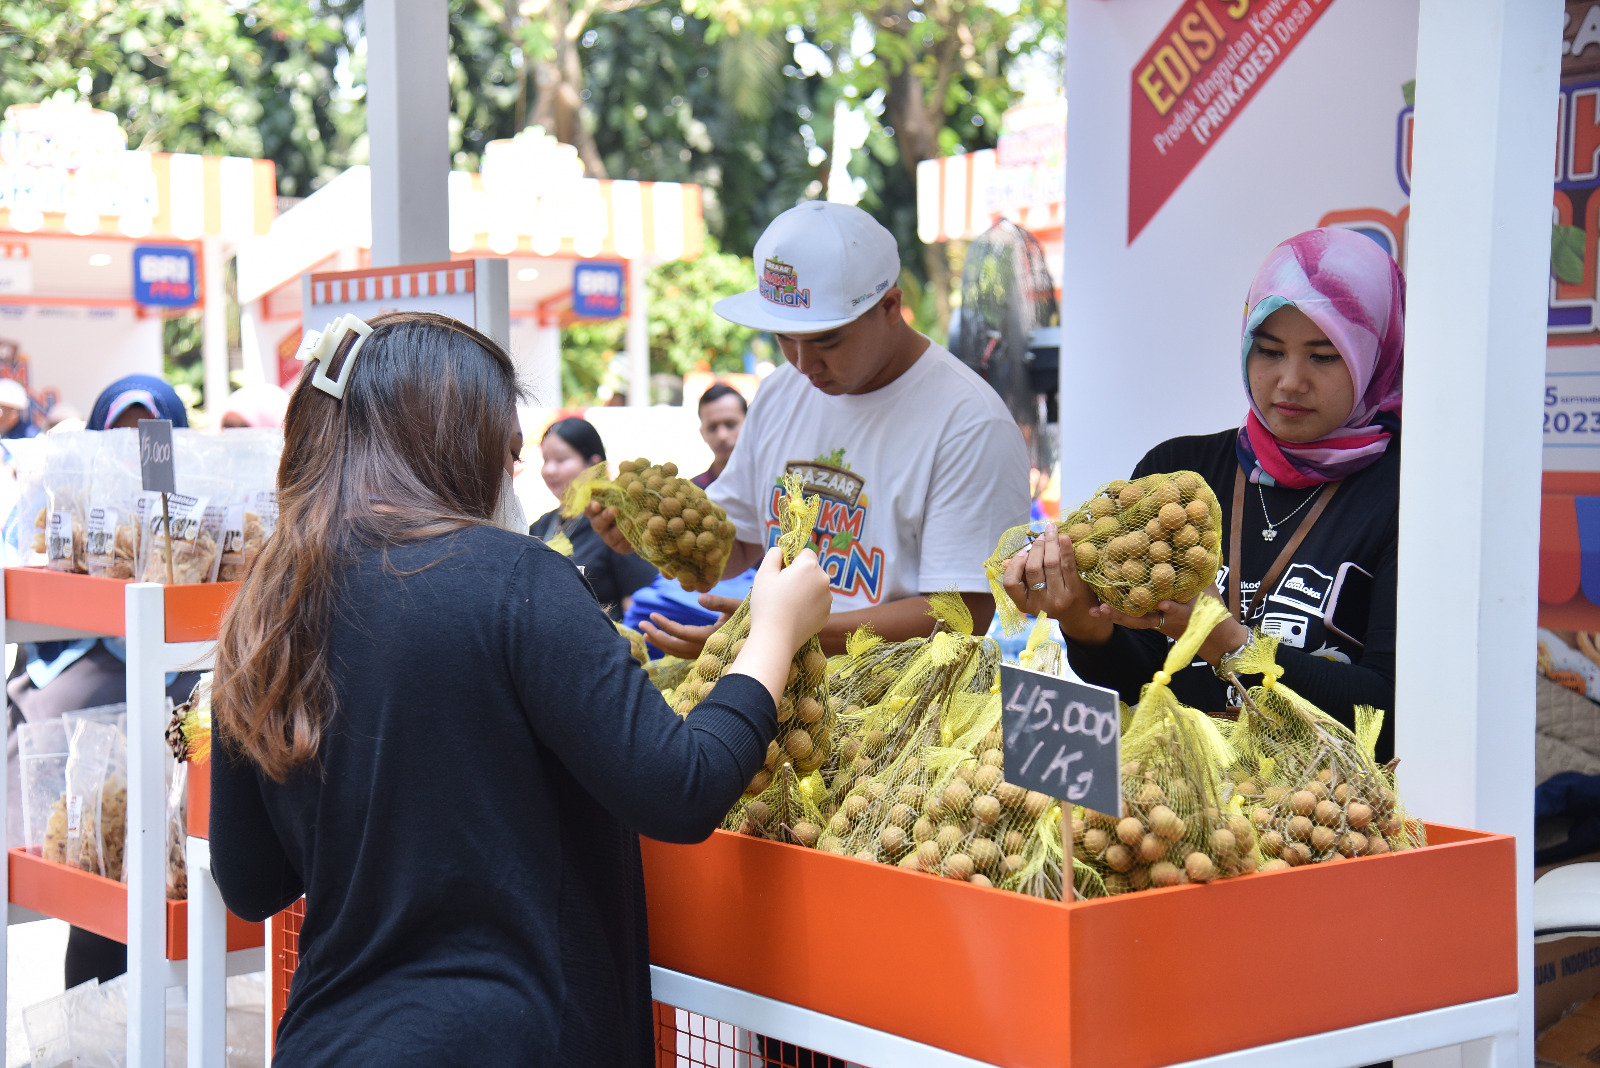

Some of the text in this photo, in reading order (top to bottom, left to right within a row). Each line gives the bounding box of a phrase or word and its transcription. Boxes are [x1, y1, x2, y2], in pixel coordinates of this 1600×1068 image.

[1137, 1, 1227, 117] EDISI
[1153, 98, 1201, 155] Produk
[1193, 31, 1256, 104] Unggulan
[1190, 34, 1280, 145] (PRUKADES)
[1005, 682, 1116, 749] 45.000
